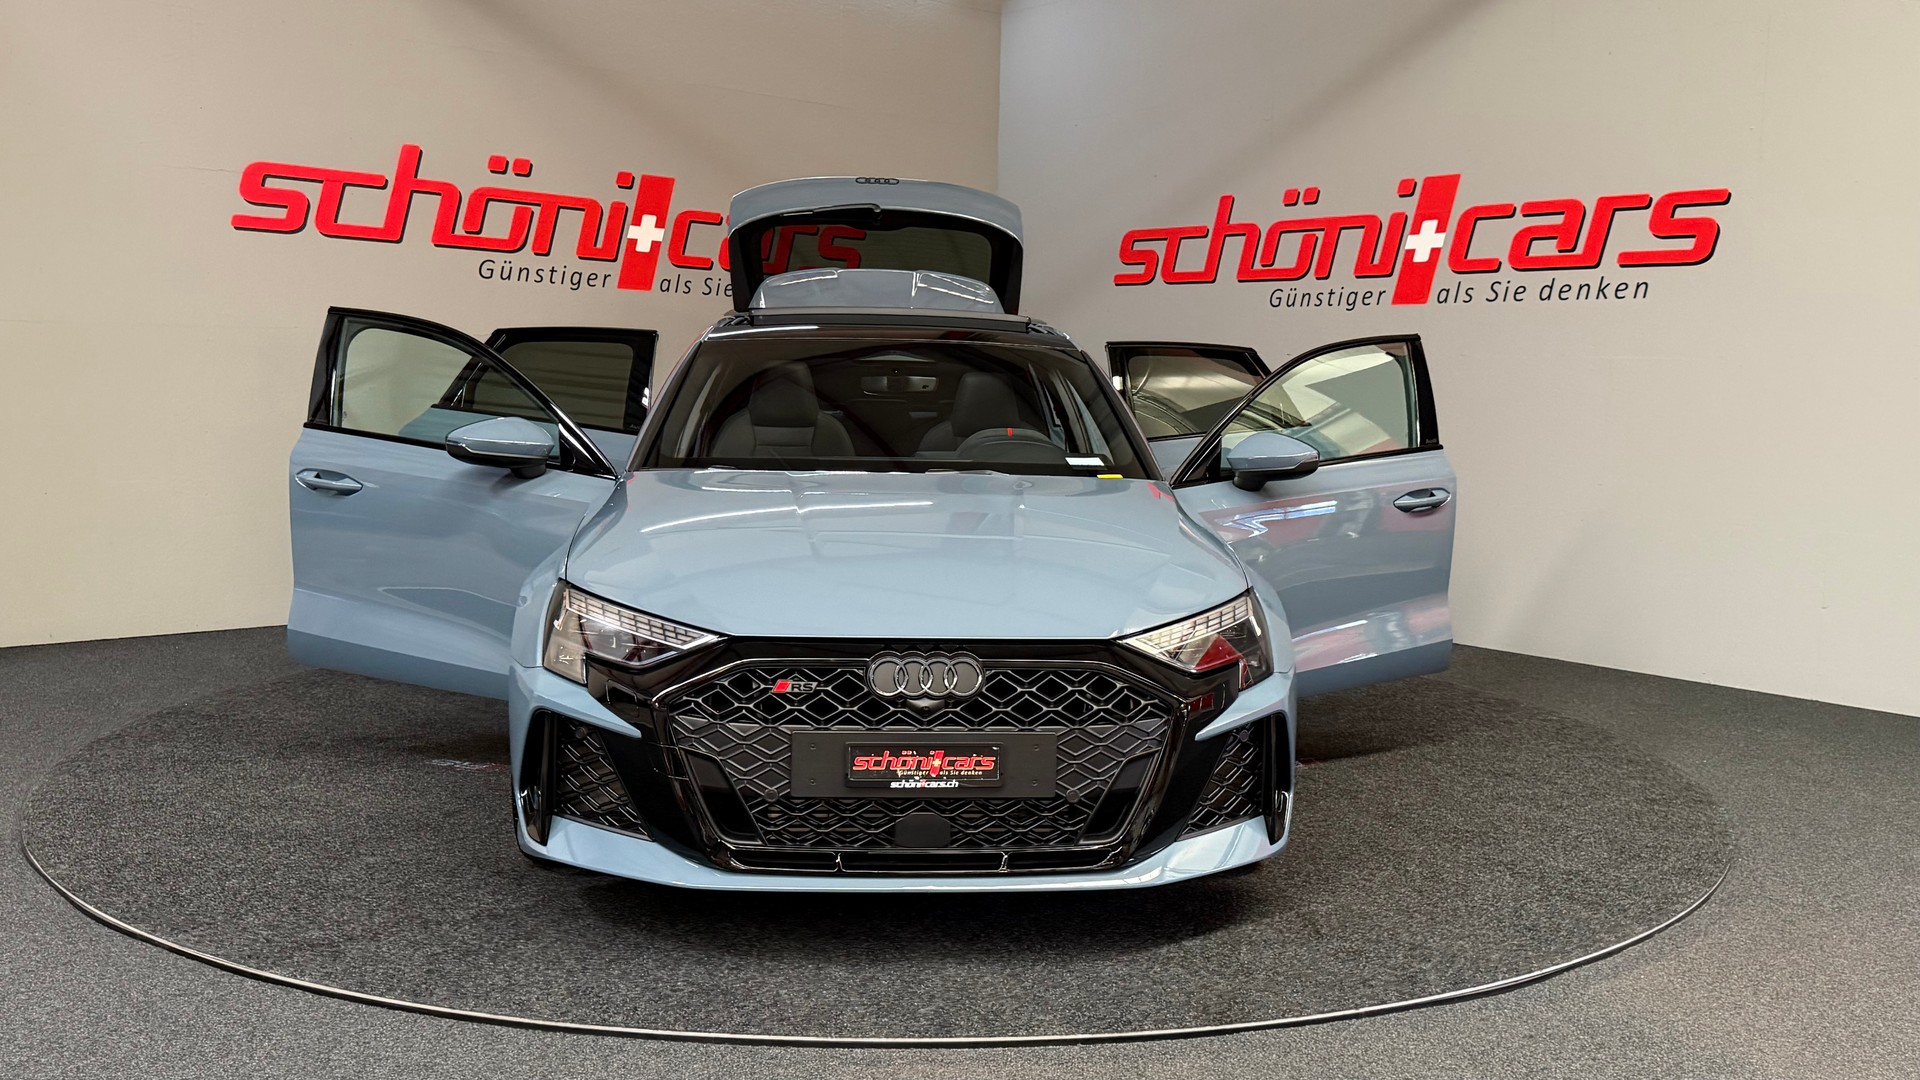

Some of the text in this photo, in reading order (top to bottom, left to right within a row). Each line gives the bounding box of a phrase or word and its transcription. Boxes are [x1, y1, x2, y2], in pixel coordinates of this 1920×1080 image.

[478, 258, 733, 298] Günstiger als Sie
[1269, 276, 1649, 312] Günstiger als Sie denken
